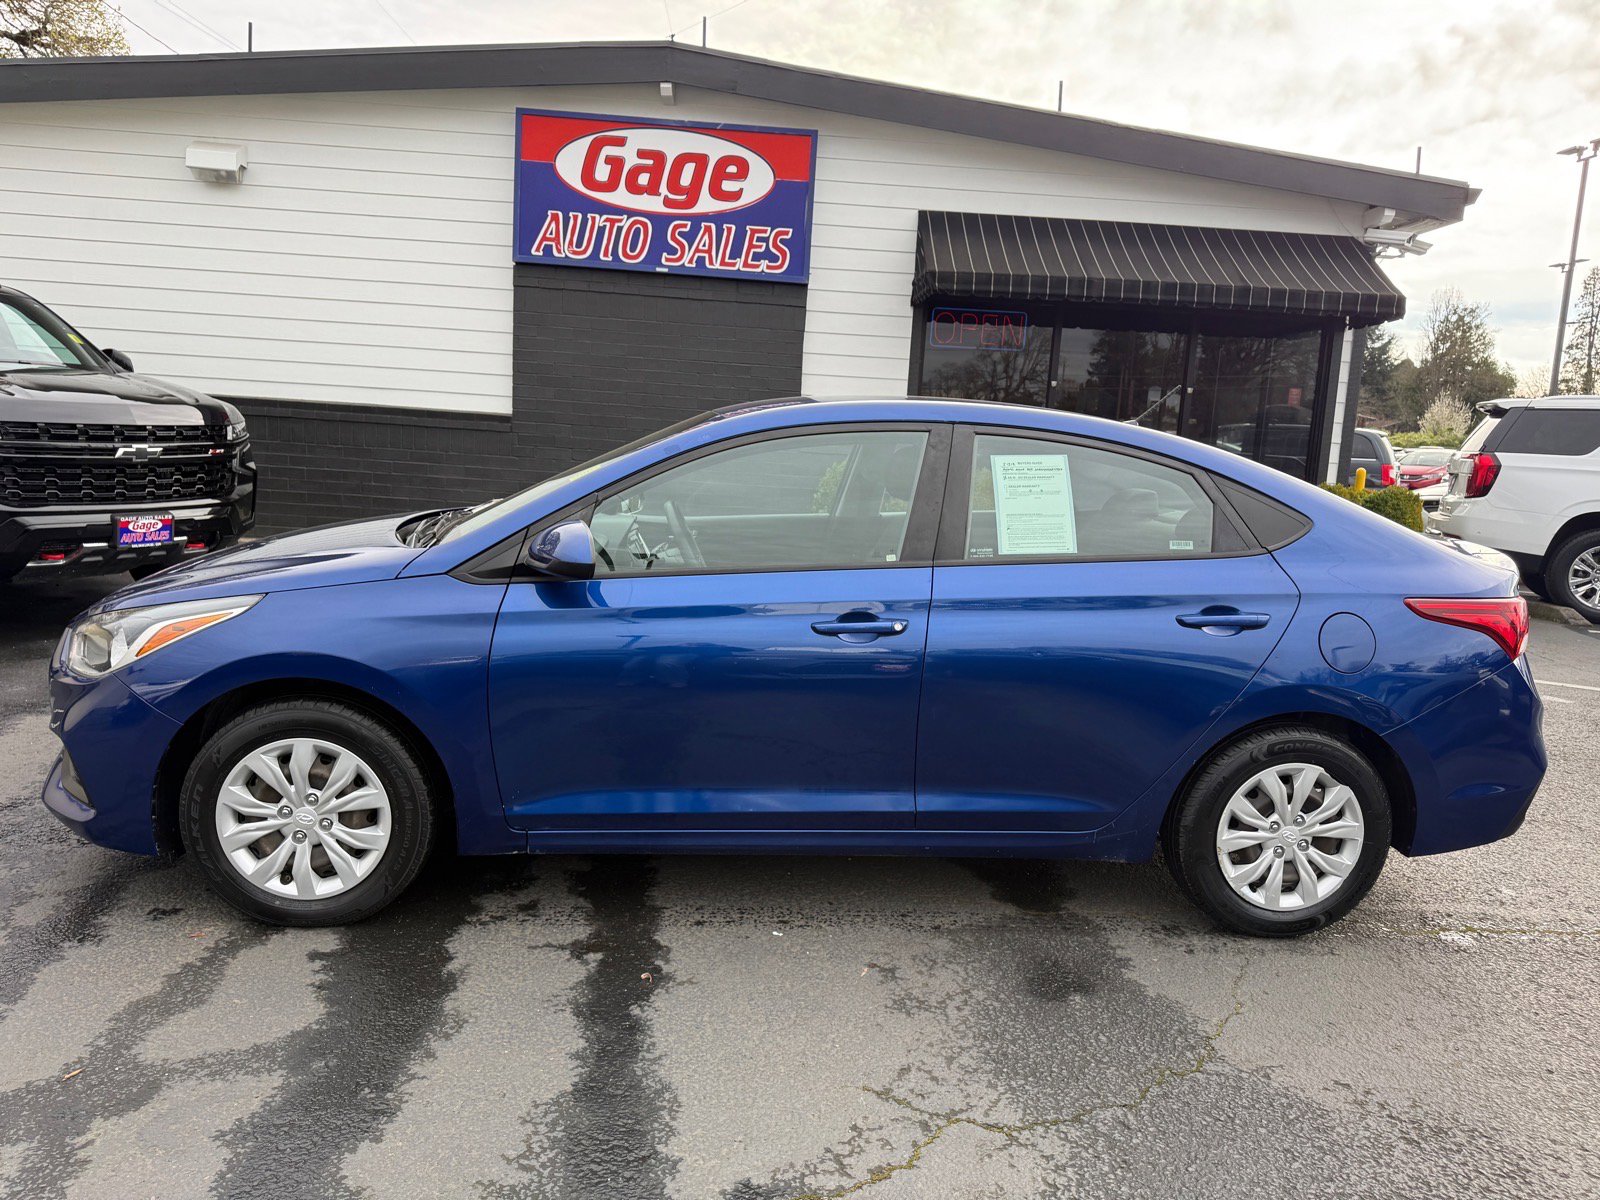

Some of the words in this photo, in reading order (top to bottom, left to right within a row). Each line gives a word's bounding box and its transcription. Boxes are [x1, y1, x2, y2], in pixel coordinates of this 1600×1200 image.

[580, 135, 750, 210] Gage
[531, 210, 653, 263] AUTO
[661, 219, 793, 274] SALES
[934, 311, 1024, 346] OPEN
[120, 533, 144, 543] AUTO
[144, 531, 170, 541] SALES
[132, 521, 159, 531] Gage
